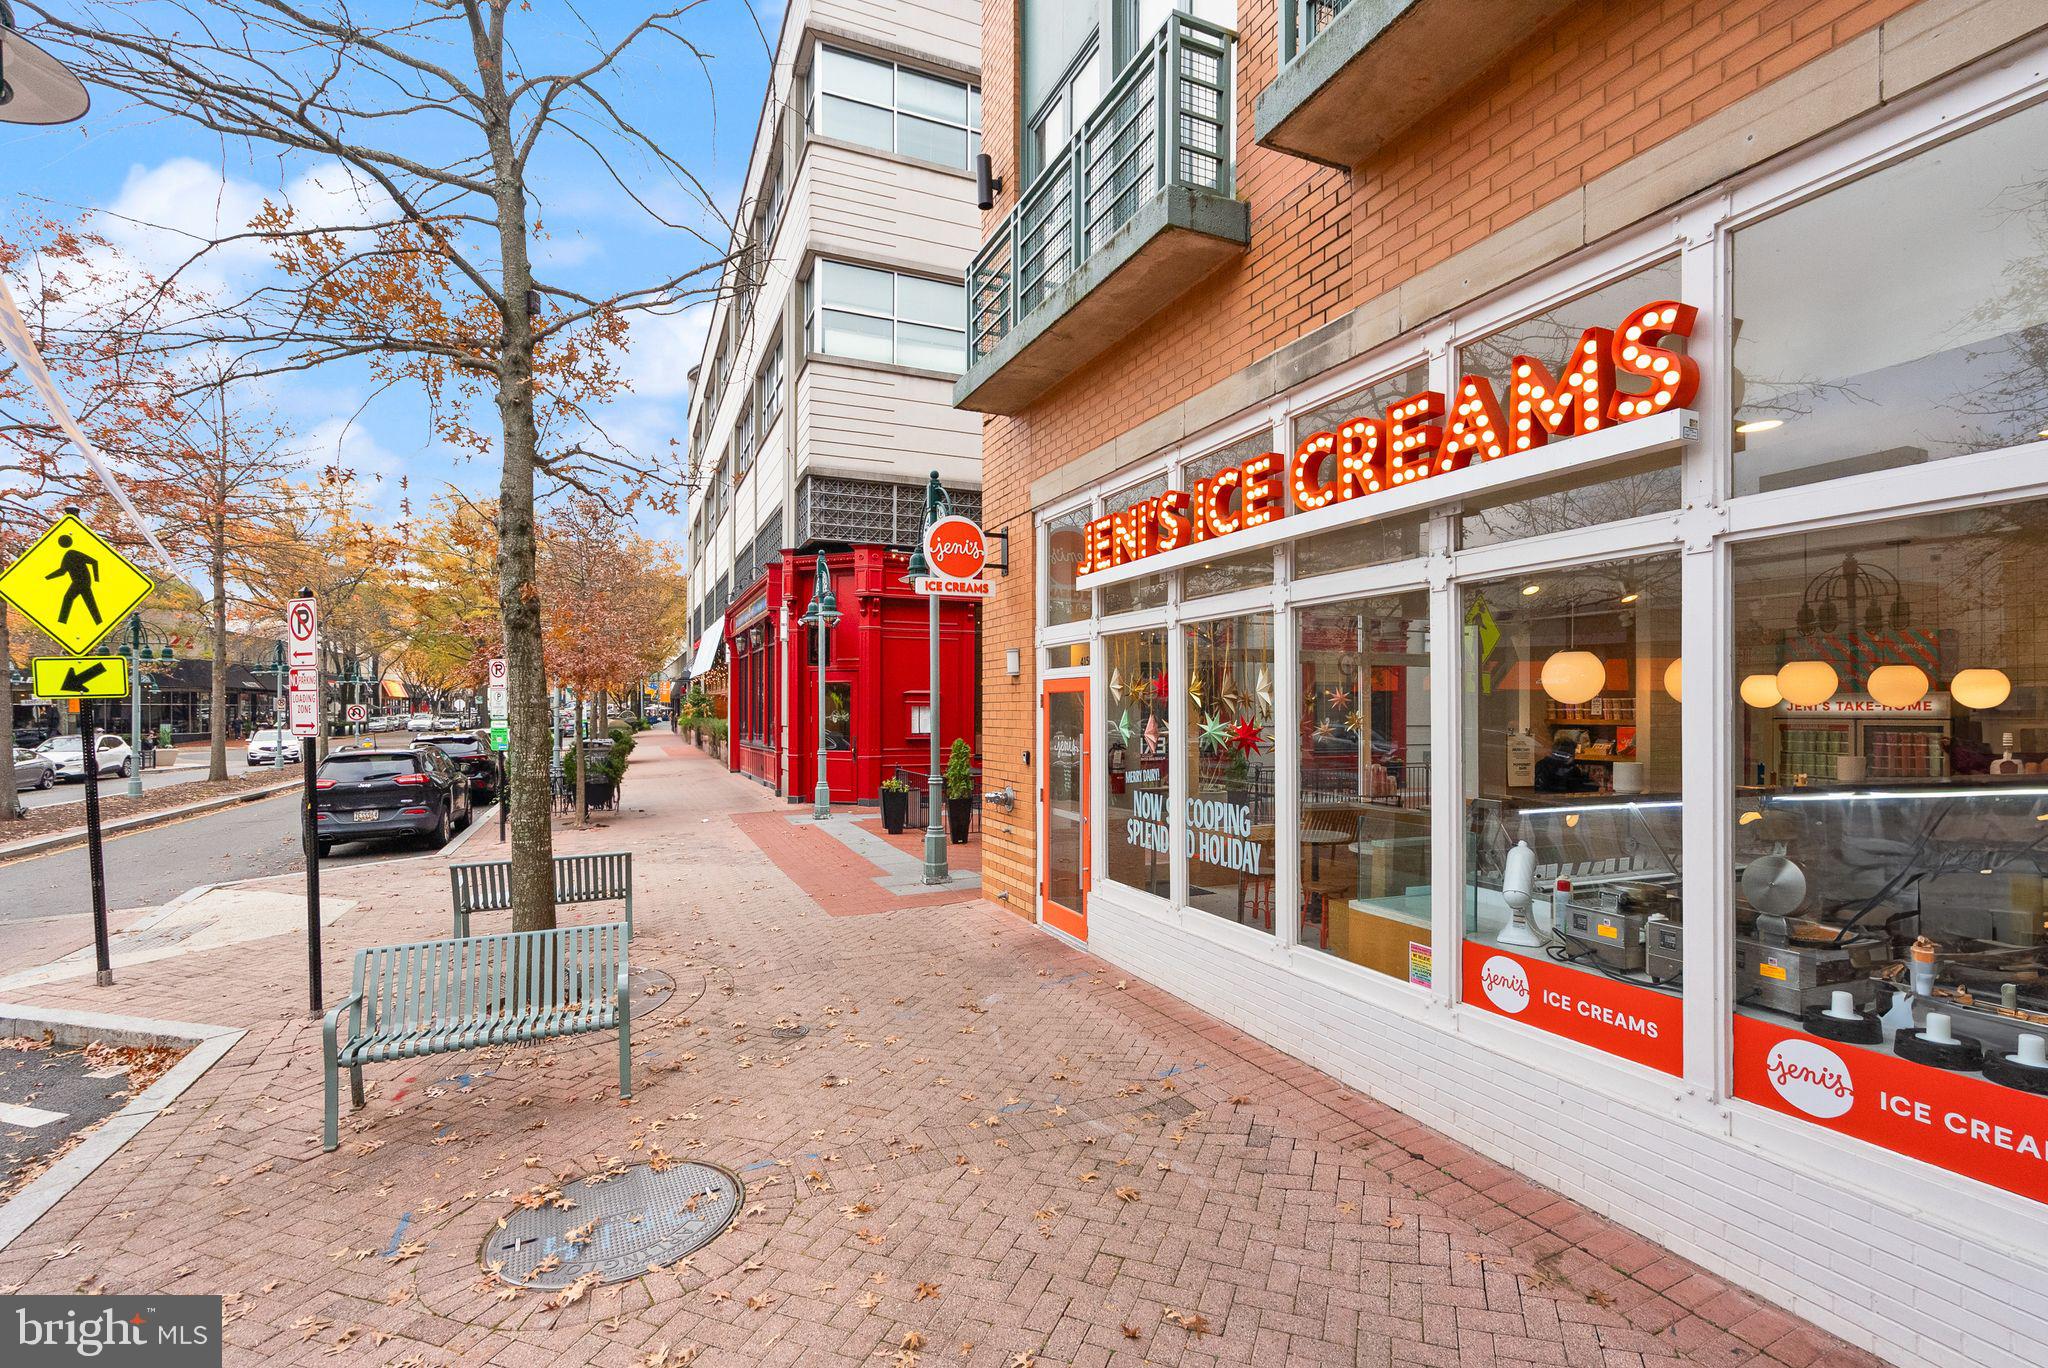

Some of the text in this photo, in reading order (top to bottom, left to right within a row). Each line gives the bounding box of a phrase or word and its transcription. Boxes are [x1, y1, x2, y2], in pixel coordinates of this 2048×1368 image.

[1077, 299, 1700, 576] JENI'S ICE CREAMS
[930, 537, 987, 562] jeni's
[925, 580, 989, 594] ICE CREAMS
[298, 675, 316, 685] PARKING
[292, 693, 316, 703] LOADING
[297, 704, 311, 714] ZONE
[1125, 769, 1142, 784] MERRY
[1133, 789, 1163, 822] NOW
[1127, 817, 1262, 876] SPLENDD HOLIDAY
[1481, 967, 1659, 1039] jeni's ICE CREAMS
[1766, 1053, 2048, 1163] jeni's ICE CREA
